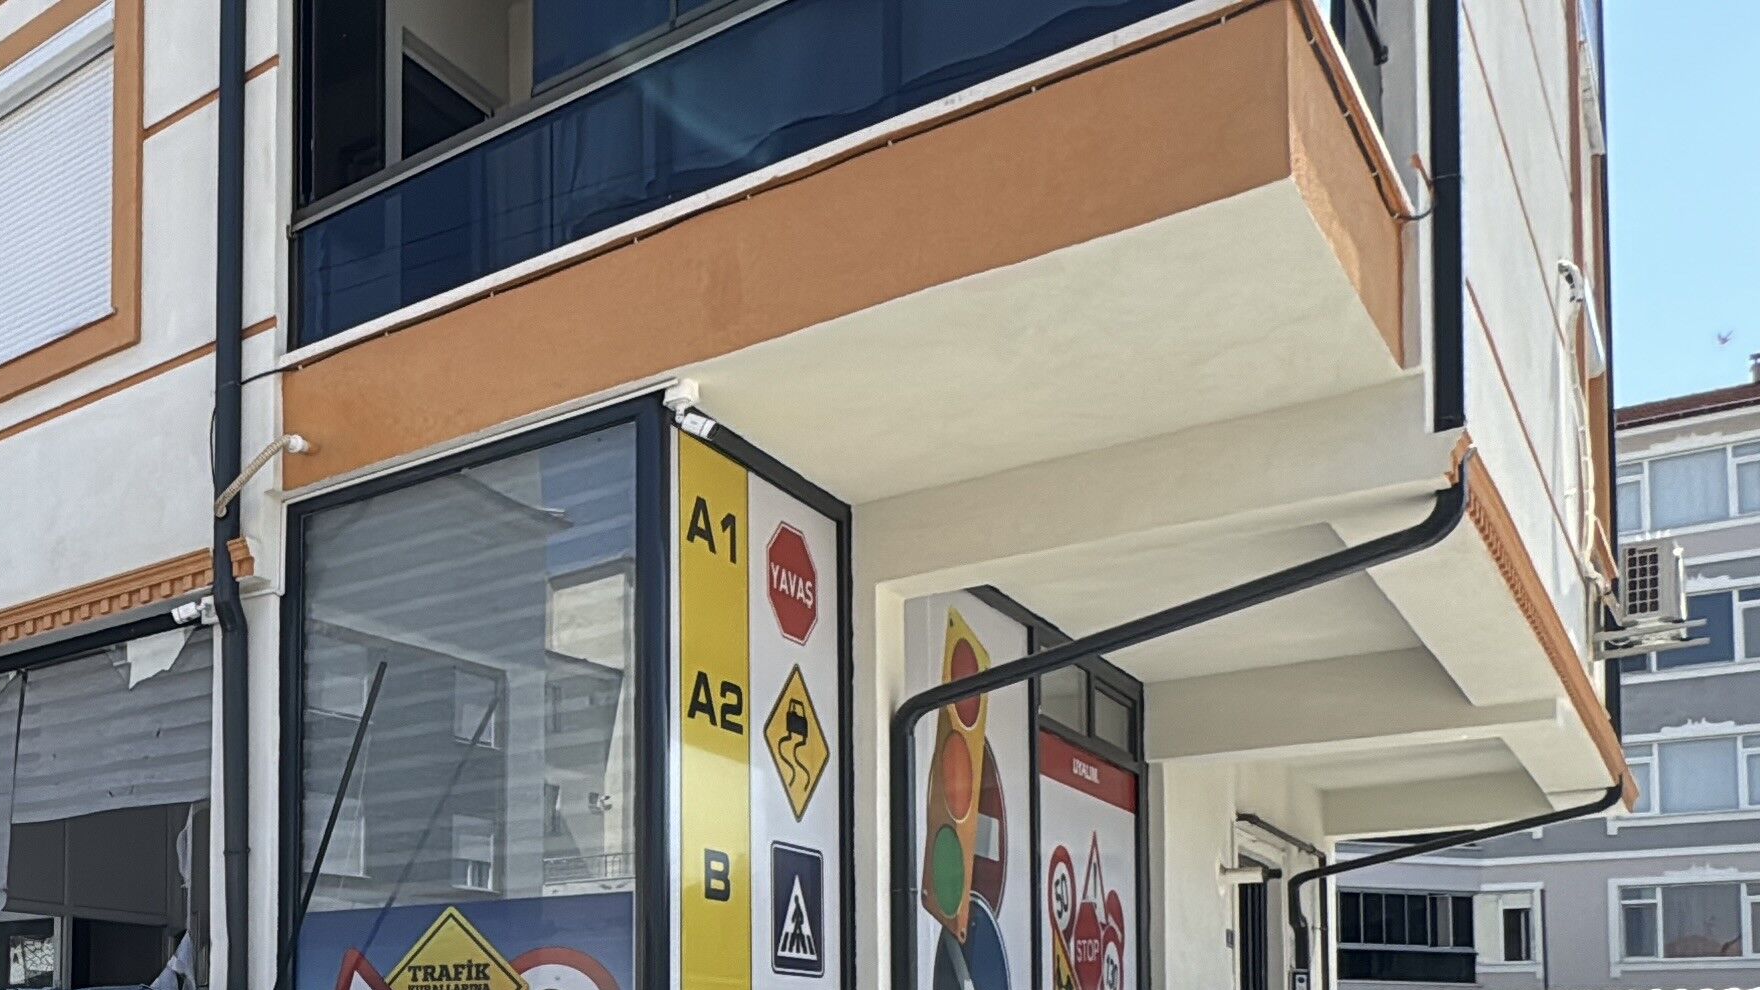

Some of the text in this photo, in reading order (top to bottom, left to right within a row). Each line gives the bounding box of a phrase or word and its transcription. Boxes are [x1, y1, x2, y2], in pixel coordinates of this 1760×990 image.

[686, 496, 738, 564] A1
[770, 561, 814, 610] YAVAŞ
[687, 670, 744, 736] A2
[704, 848, 731, 902] B
[1054, 872, 1069, 920] 50
[407, 959, 491, 983] TRAFİK
[1076, 939, 1100, 963] STOP
